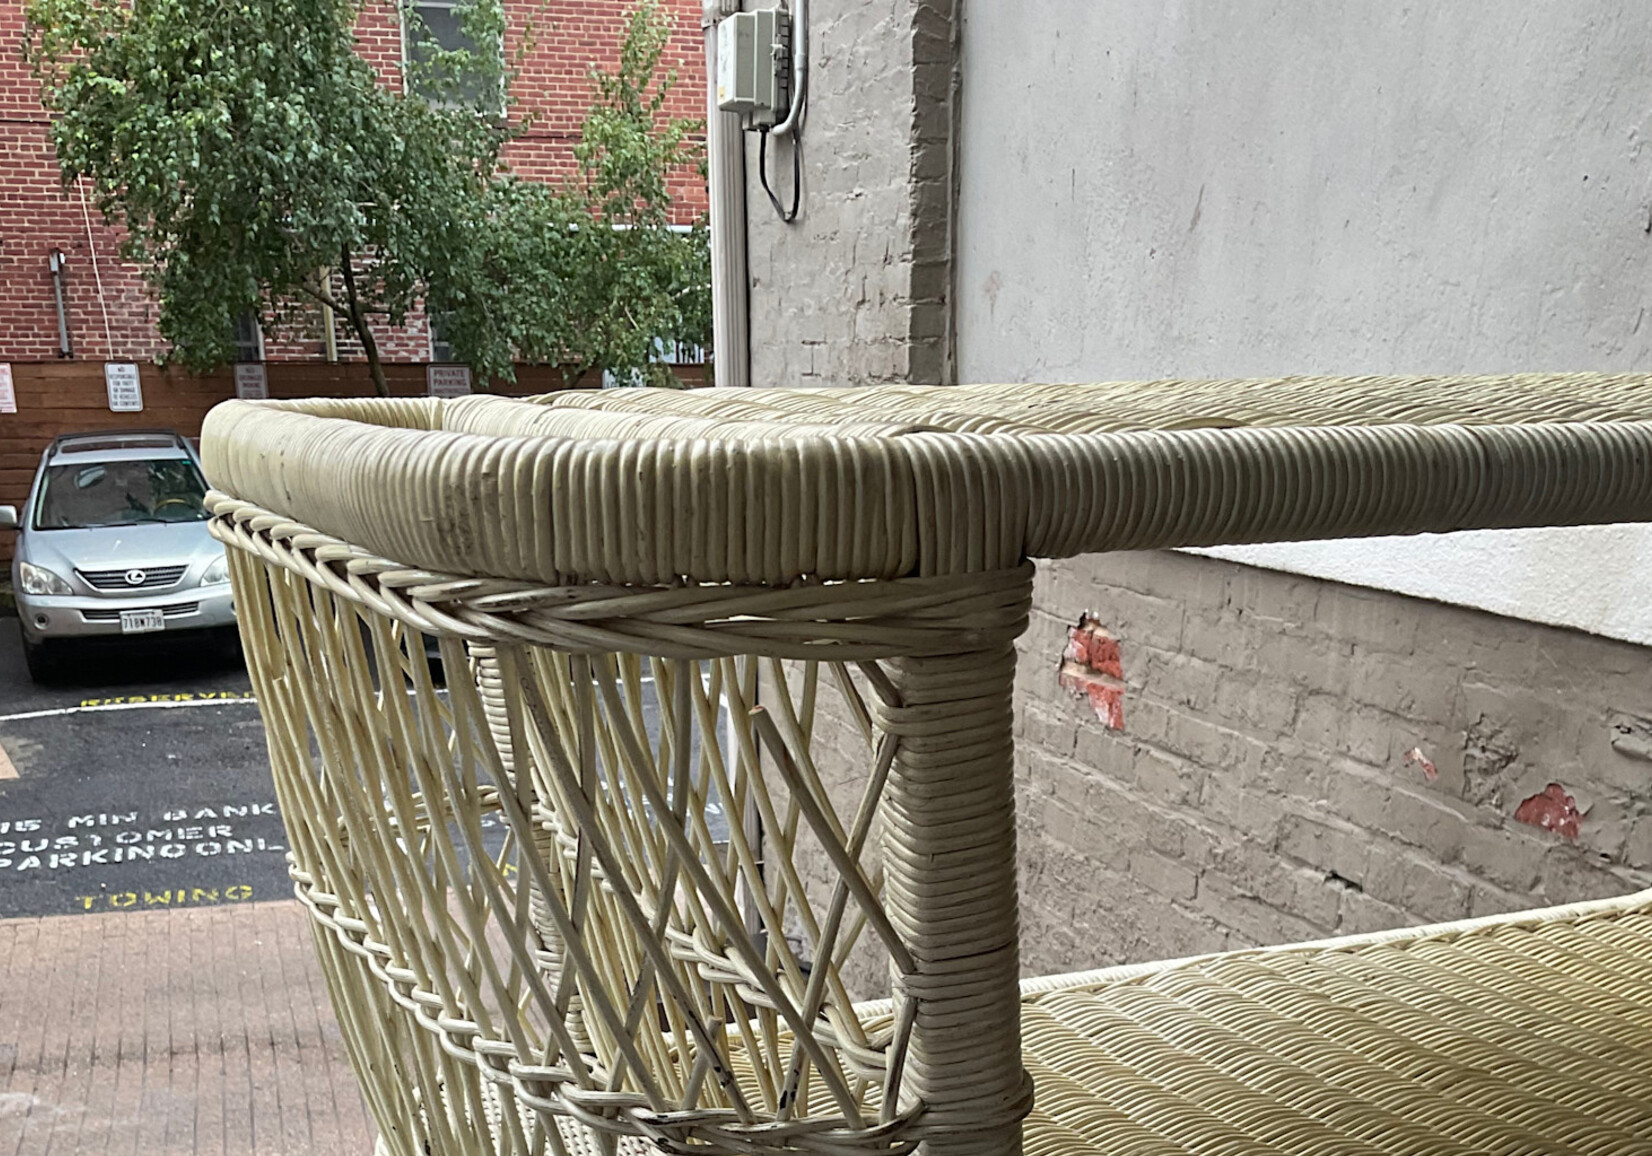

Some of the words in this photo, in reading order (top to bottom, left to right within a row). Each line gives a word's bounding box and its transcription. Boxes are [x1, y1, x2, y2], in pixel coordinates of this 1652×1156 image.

[68, 811, 138, 828] MIN
[195, 837, 285, 857] ONL
[75, 885, 252, 909] TOWING
